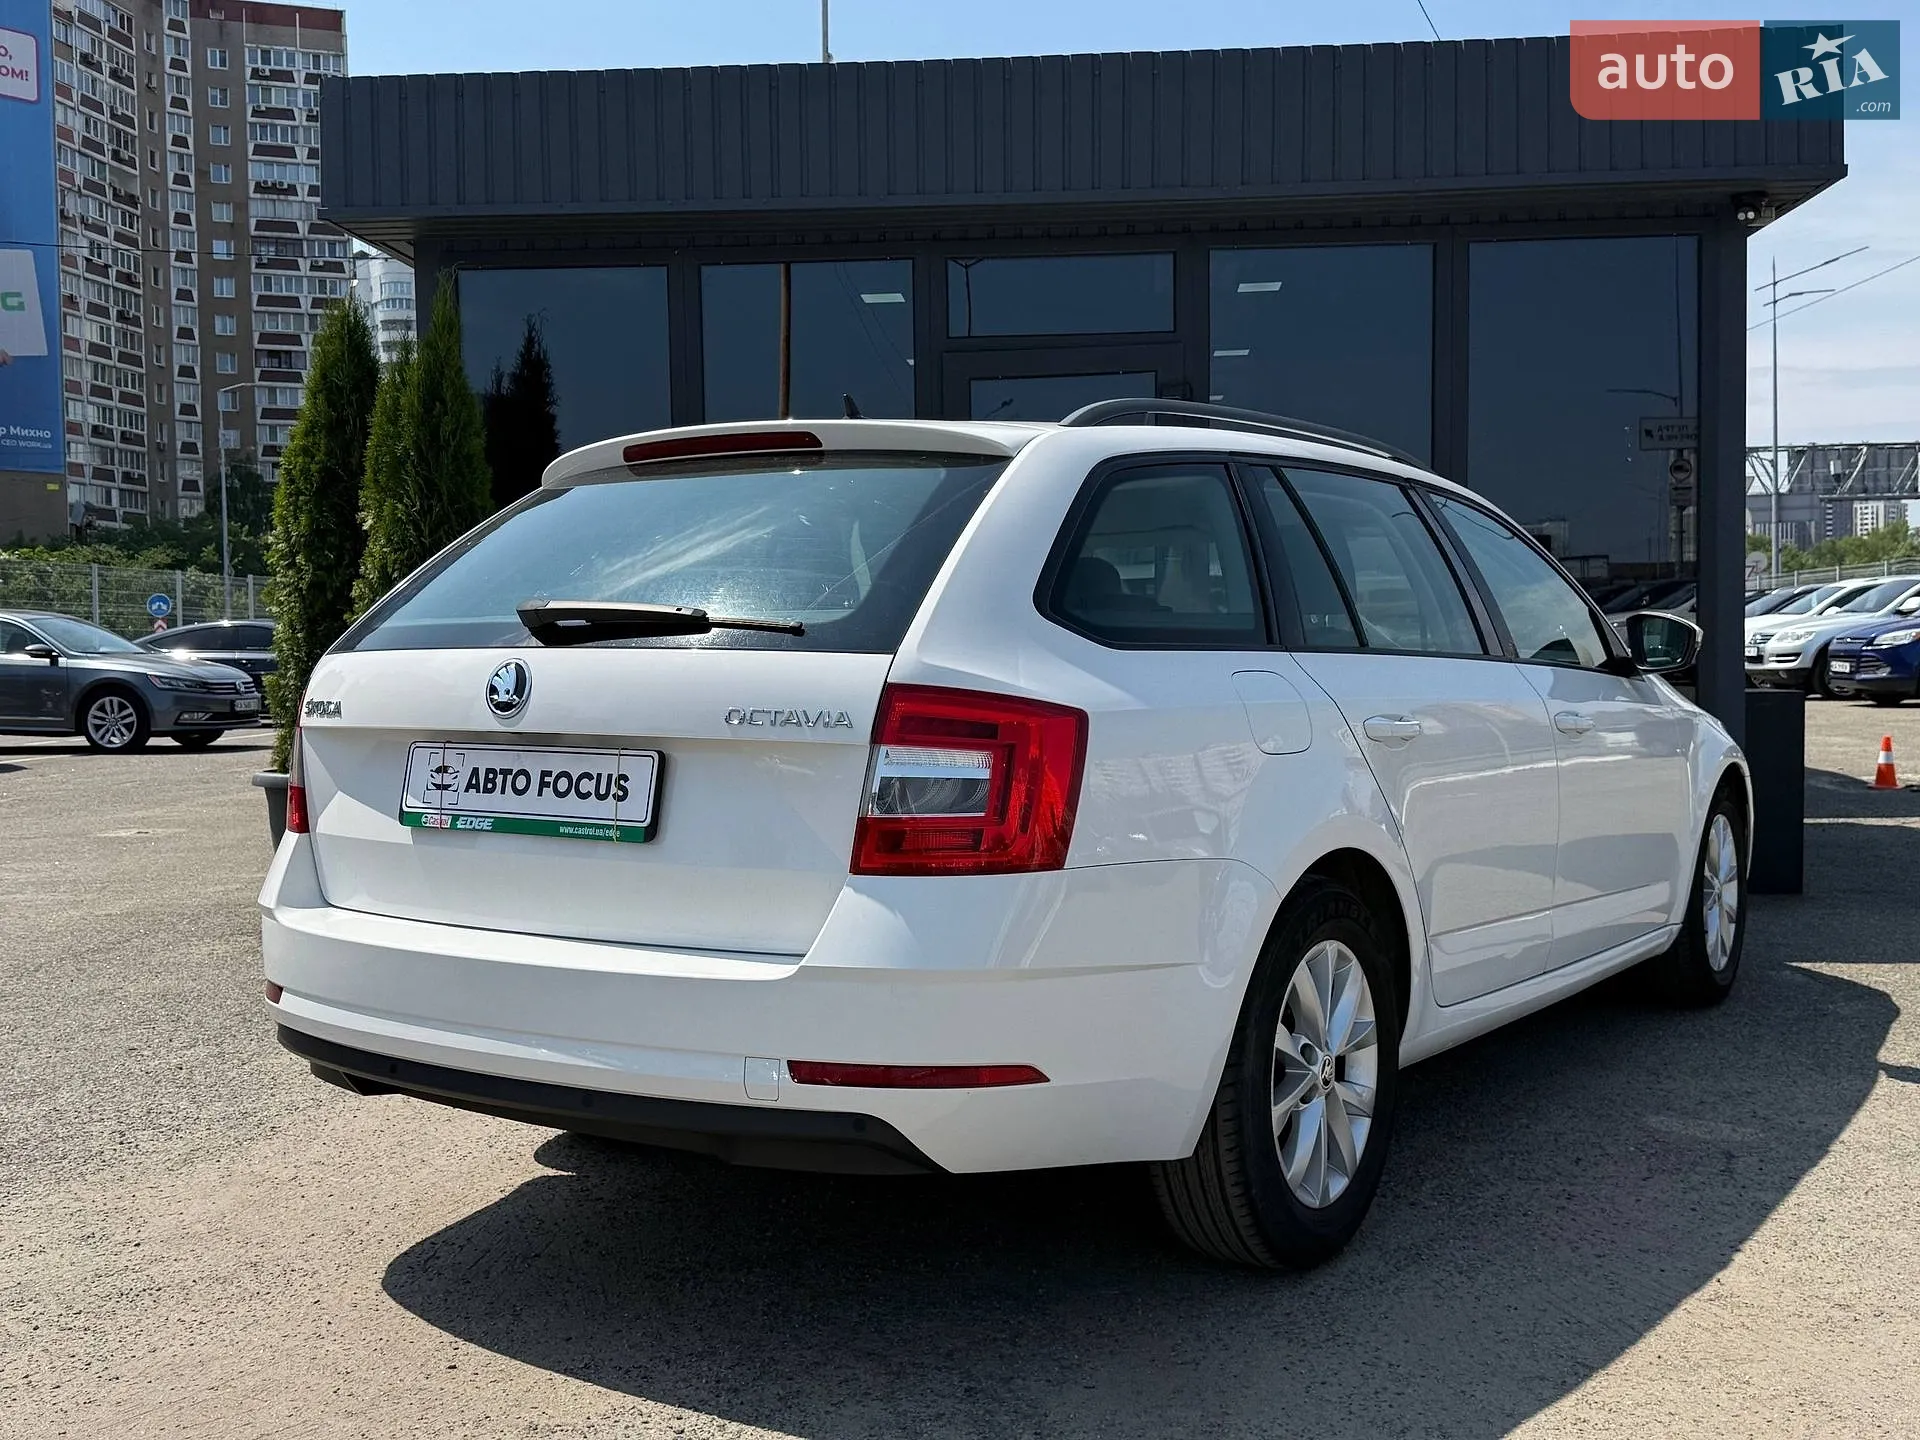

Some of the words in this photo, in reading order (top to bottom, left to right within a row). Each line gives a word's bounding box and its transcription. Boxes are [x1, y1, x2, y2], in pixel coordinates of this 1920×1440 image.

[10, 425, 52, 438] Михно
[724, 706, 854, 728] OCTAVIA
[537, 769, 630, 803] FOCUS
[456, 816, 494, 830] EDGE
